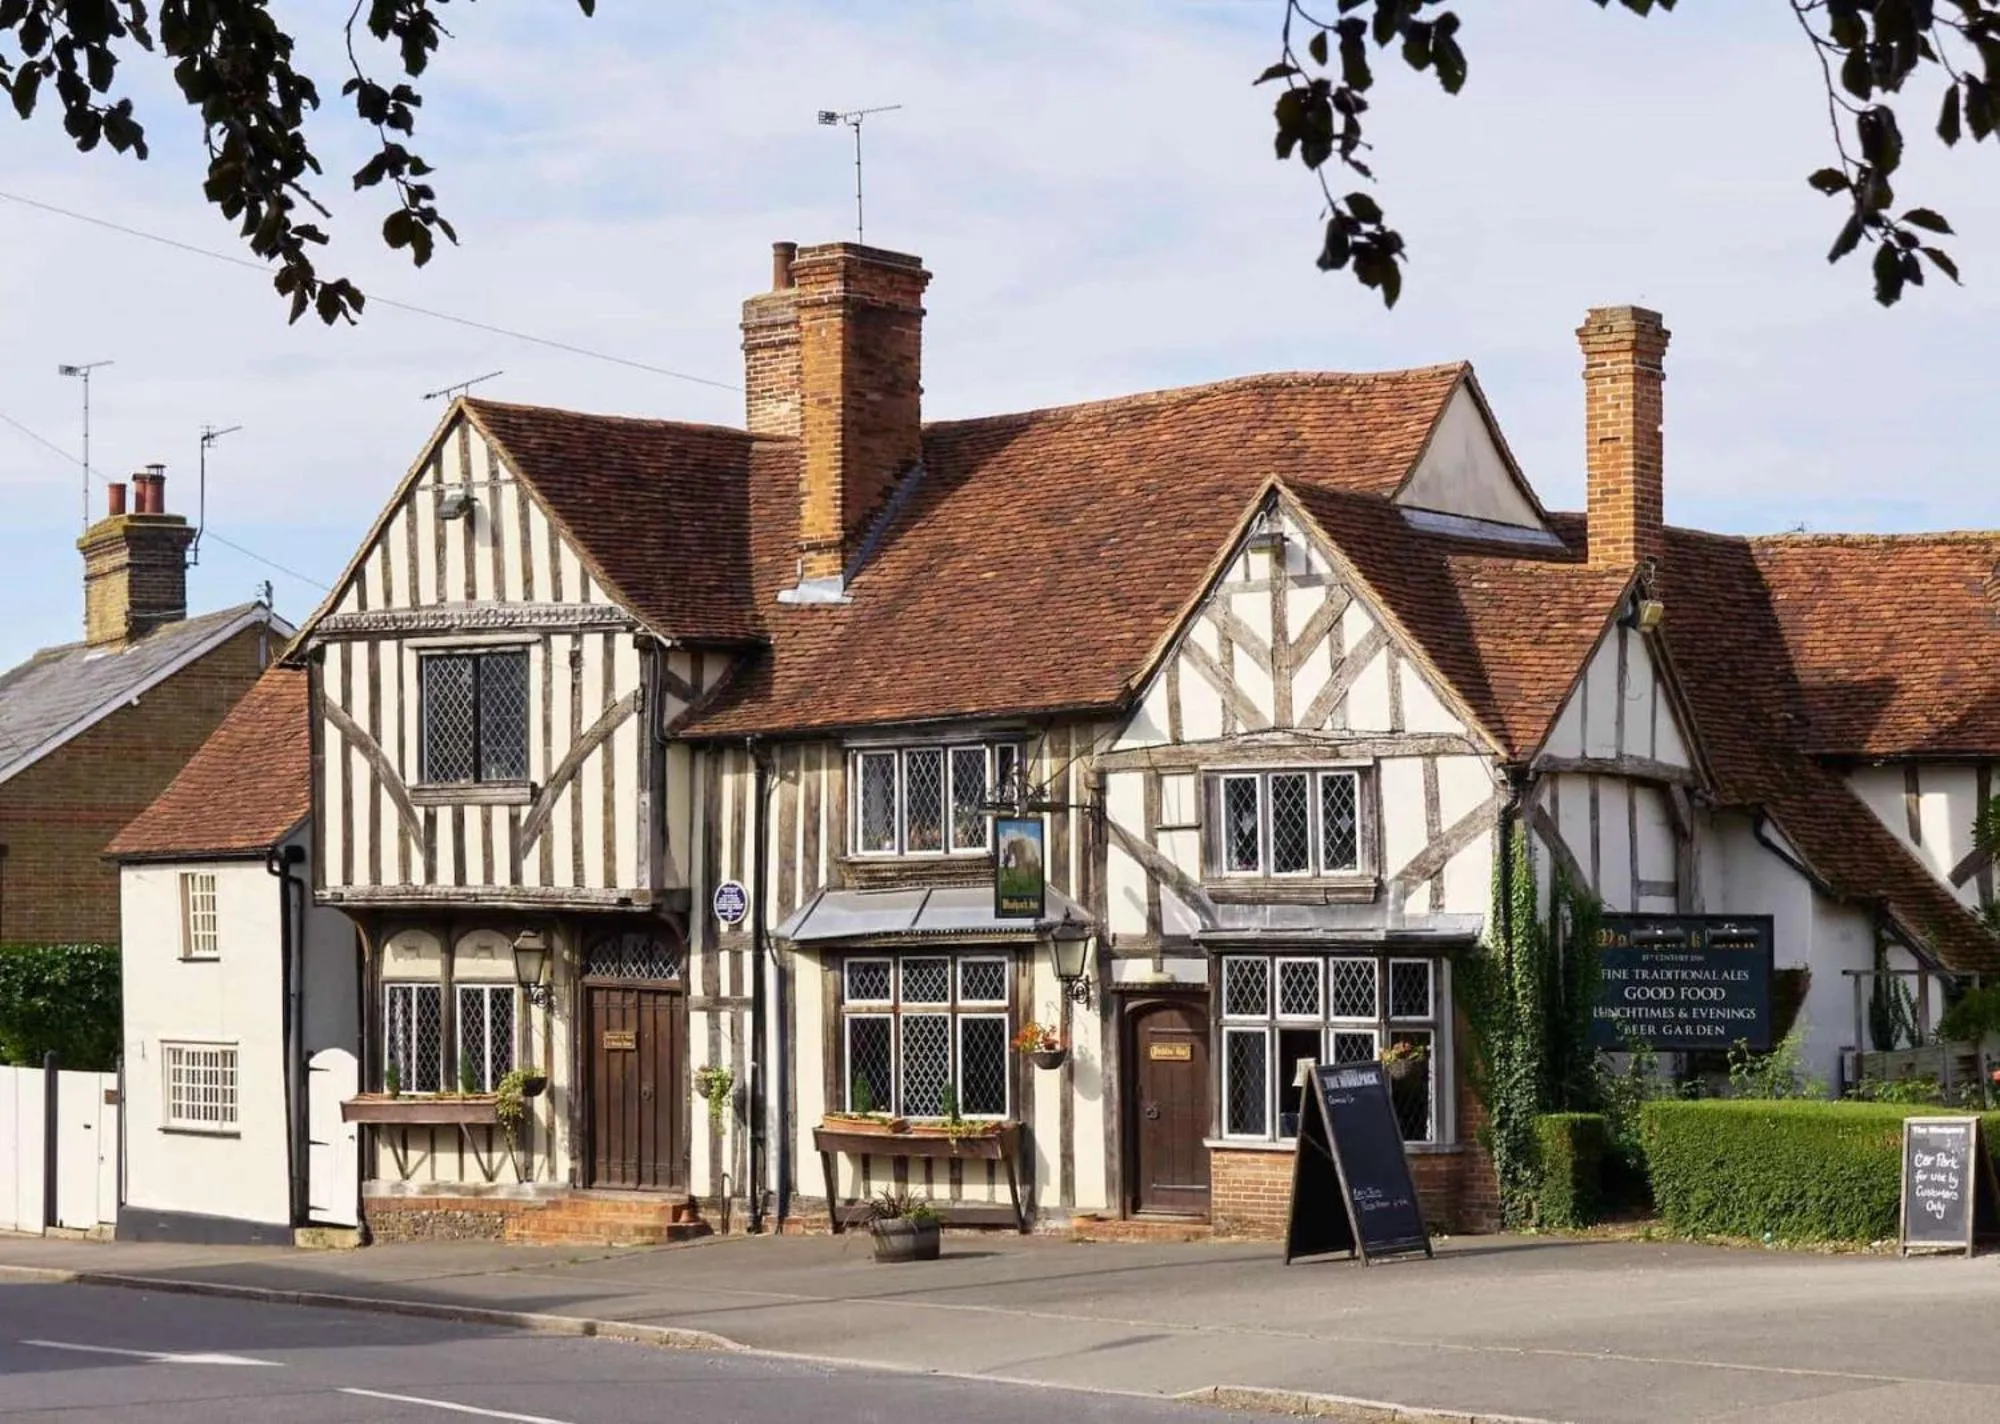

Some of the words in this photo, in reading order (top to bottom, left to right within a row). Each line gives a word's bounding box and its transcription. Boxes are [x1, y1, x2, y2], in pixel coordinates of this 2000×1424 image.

[1601, 968, 1629, 980] FINE
[1634, 968, 1720, 981] TRADITIONAL
[1720, 969, 1749, 981] ALES
[1623, 986, 1675, 1001] GOOD
[1680, 986, 1726, 1001] FOOD
[1593, 1006, 1675, 1019] LUNCHTIMES
[1678, 1007, 1688, 1019] &
[1692, 1007, 1757, 1020] EVENINGS
[1624, 1024, 1656, 1036] BEER
[1662, 1025, 1725, 1036] GARDEN
[1914, 1150, 1935, 1167] Car
[1936, 1152, 1960, 1169] Park
[1915, 1169, 1928, 1184] for
[1930, 1173, 1946, 1182] use
[1948, 1171, 1959, 1189] by
[1915, 1184, 1959, 1200] Customers
[1926, 1200, 1946, 1220] Only
